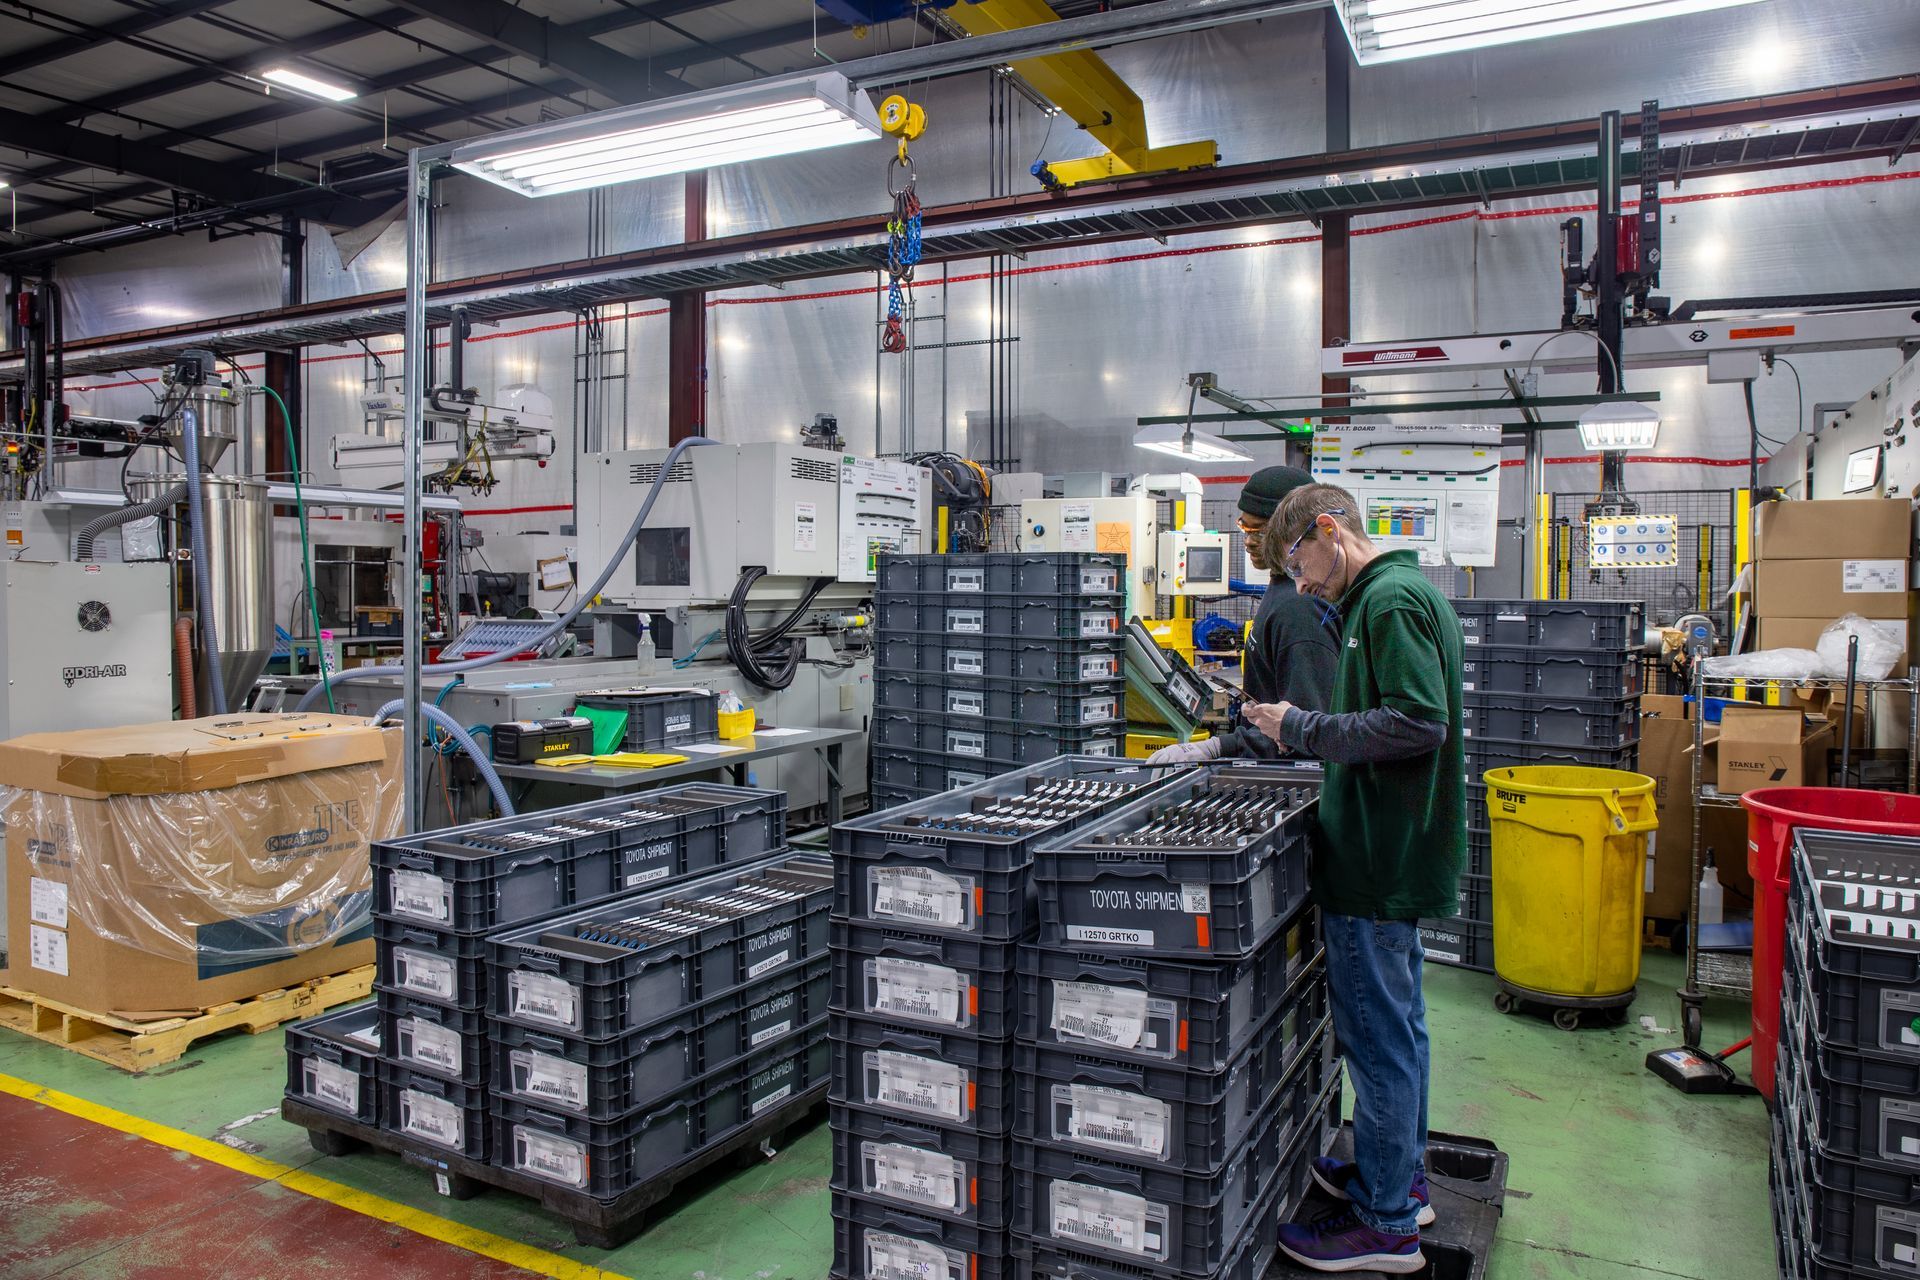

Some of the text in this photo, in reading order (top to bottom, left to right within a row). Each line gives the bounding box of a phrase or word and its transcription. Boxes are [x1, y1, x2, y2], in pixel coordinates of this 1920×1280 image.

[1374, 350, 1418, 361] Wittmann
[1460, 618, 1478, 628] PMENT
[74, 664, 127, 680] DRI-AIR
[543, 743, 570, 752] STANLEY
[1144, 743, 1168, 751] BRU
[1728, 761, 1766, 769] STANLEY
[1496, 789, 1526, 804] BRUTE
[314, 800, 359, 835] TPE
[625, 842, 673, 864] TOYOTA SHIPMENT
[1089, 889, 1184, 911] TOYOTA SHIPMEN
[748, 925, 793, 952] TOYOTA SHIPMENT
[1084, 930, 1108, 940] 12570
[1108, 931, 1139, 942] GRTKO
[1420, 928, 1460, 944] OYOTA SHIPMENT
[750, 992, 794, 1022] TOYOTA SHIPMENT
[752, 1058, 795, 1090] TOYOTA SHIPMENT
